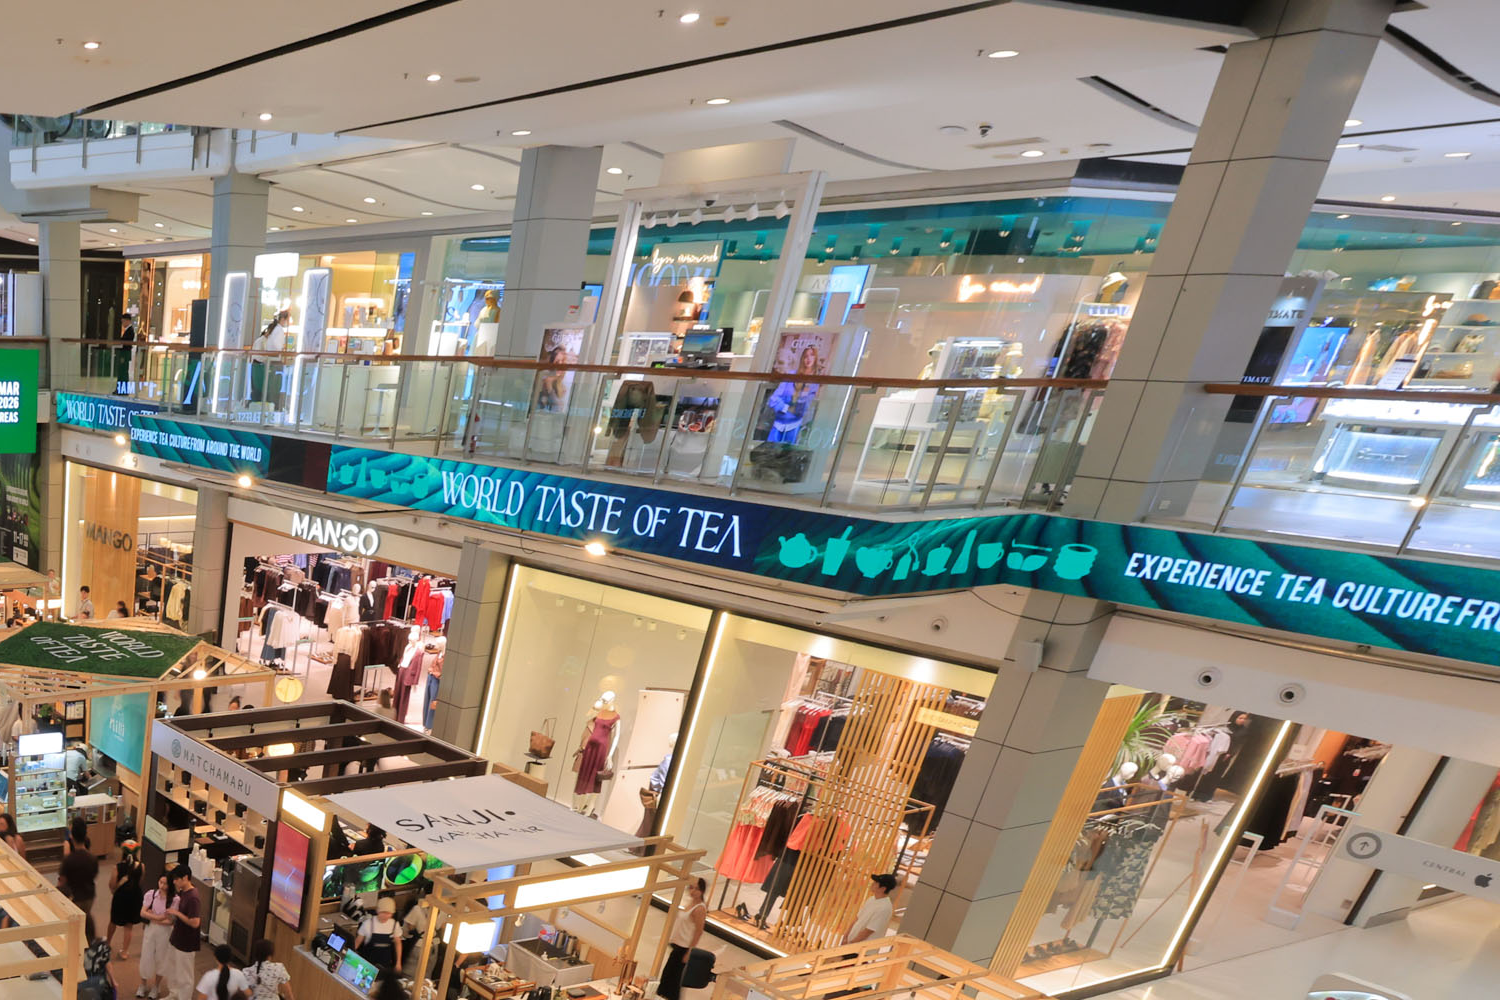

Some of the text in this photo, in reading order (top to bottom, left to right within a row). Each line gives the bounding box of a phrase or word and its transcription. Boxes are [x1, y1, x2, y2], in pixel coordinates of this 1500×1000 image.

[66, 399, 96, 423] WORLD
[97, 404, 126, 428] TASTE
[130, 427, 158, 445] EXPERIENCE
[159, 430, 169, 444] TEA
[206, 439, 228, 456] AROUND
[229, 442, 240, 459] THE
[241, 445, 262, 463] WORLD
[441, 471, 742, 557] WORLD TASTE OF TEA
[85, 522, 133, 552] MANGO
[291, 511, 381, 556] MANGO
[1124, 552, 1272, 598] EXPERIENCE
[1275, 572, 1327, 606] TEA
[63, 633, 131, 661] TASTE
[98, 631, 165, 659] WORLD
[183, 748, 252, 797] MATCHAMARU
[396, 809, 506, 832] SANJI
[1422, 860, 1467, 878] CENTRAL
